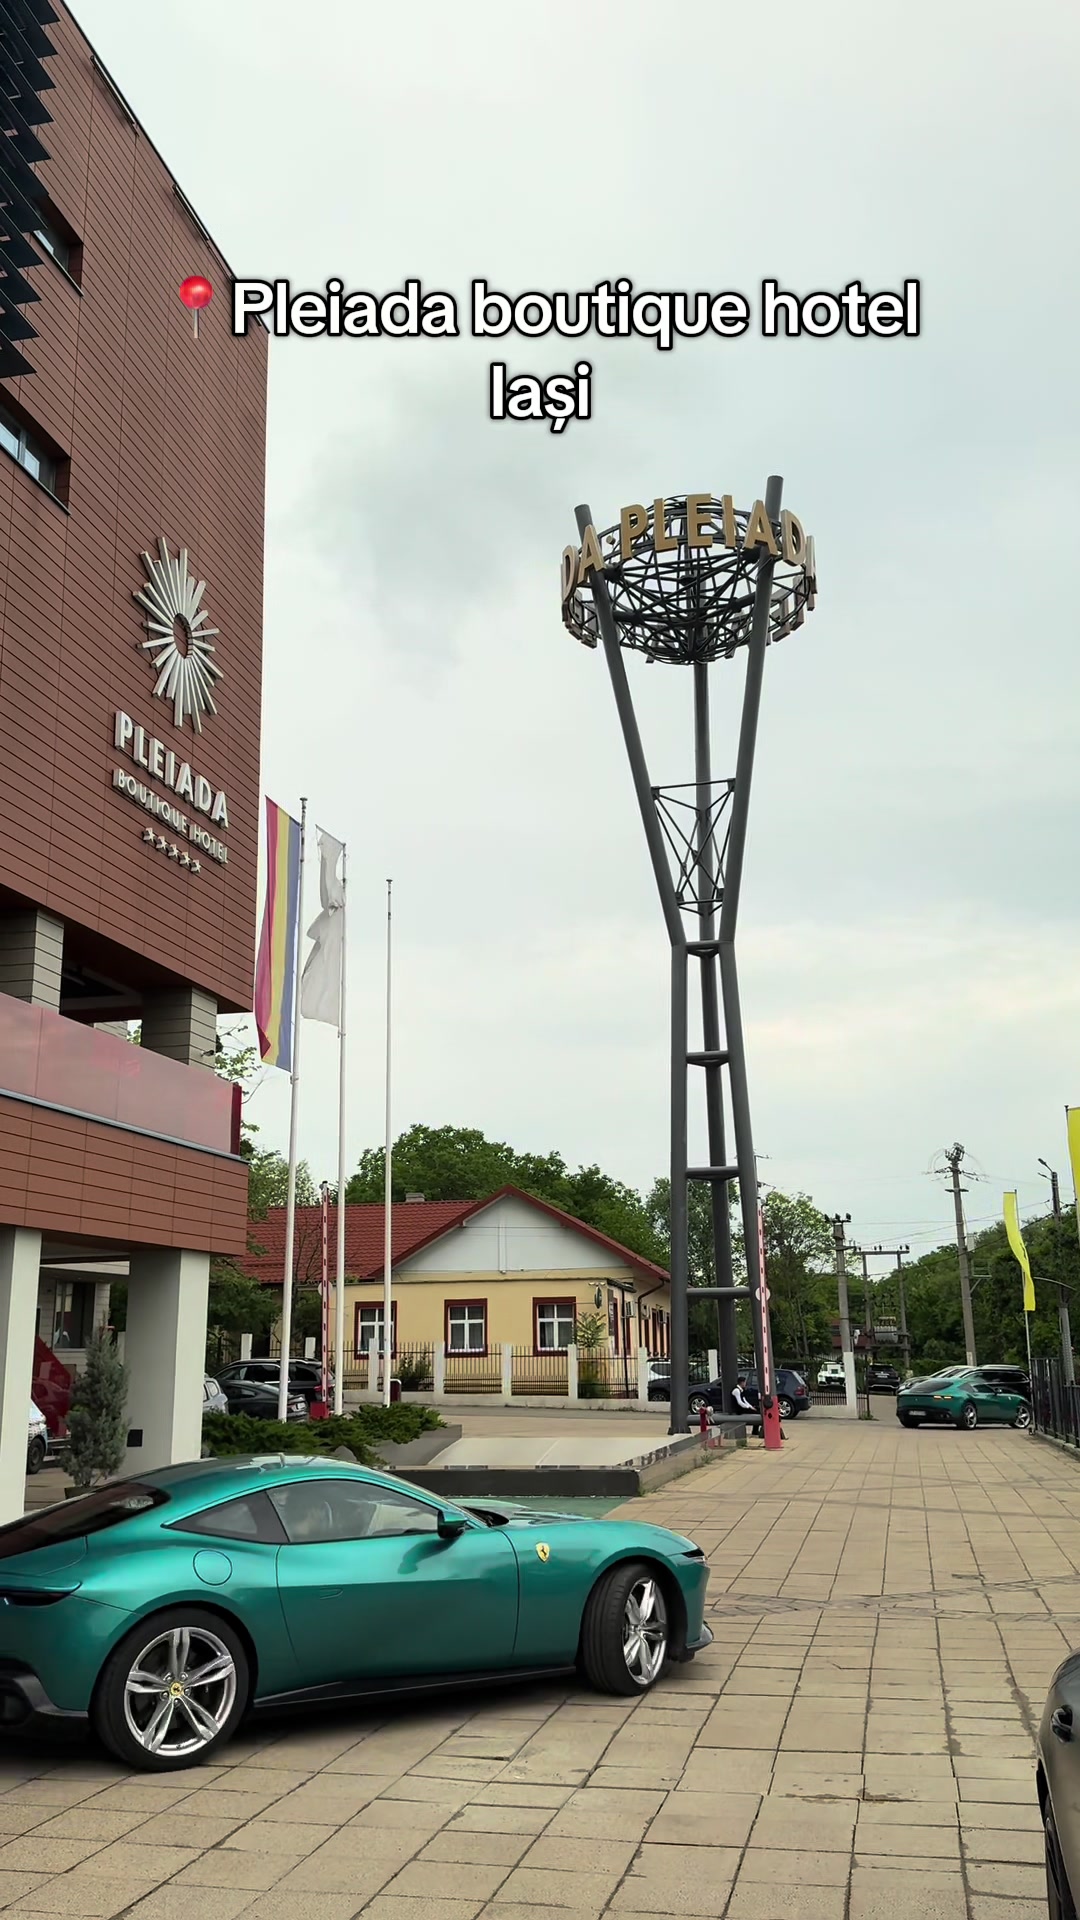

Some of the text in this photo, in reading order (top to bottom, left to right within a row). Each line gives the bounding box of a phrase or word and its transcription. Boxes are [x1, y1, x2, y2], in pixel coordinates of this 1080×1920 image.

[113, 768, 228, 864] BOUTIQUE HOTEL
[115, 711, 229, 829] PLEIADA
